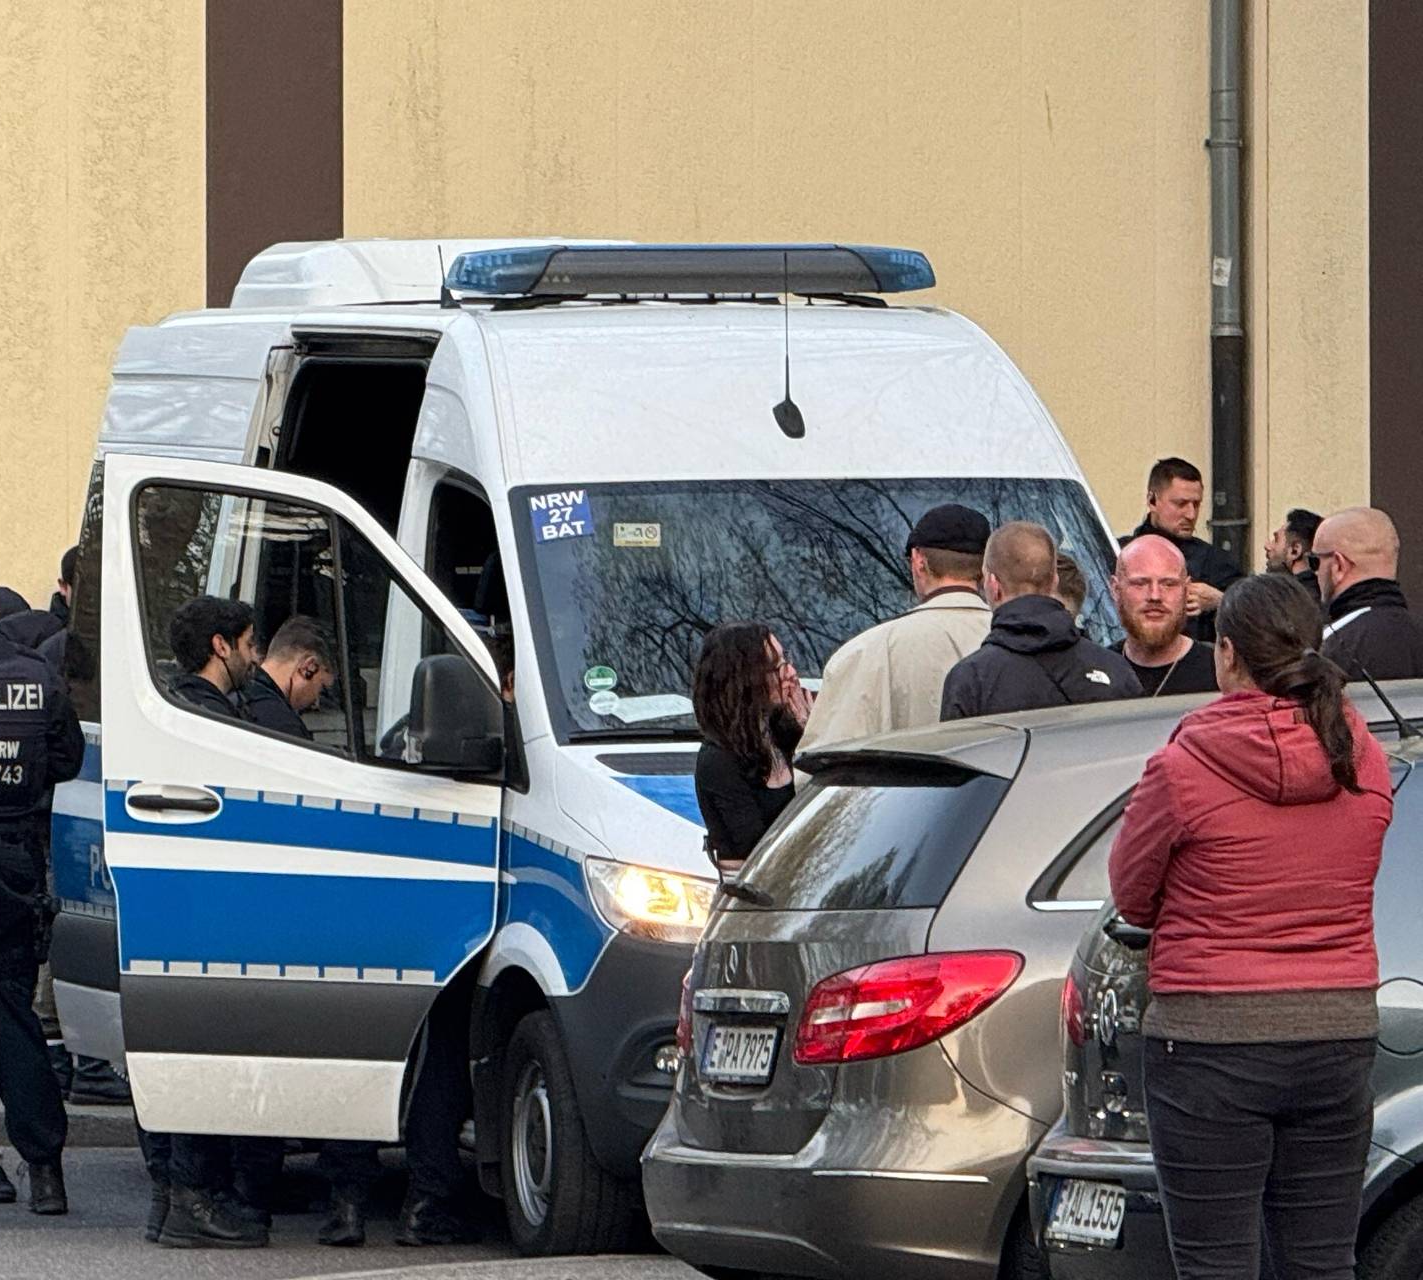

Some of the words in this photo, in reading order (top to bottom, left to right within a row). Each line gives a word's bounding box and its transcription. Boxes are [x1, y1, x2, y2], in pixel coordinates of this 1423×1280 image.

[530, 490, 585, 511] NRW
[548, 507, 573, 523] 27
[541, 521, 585, 540] BAT
